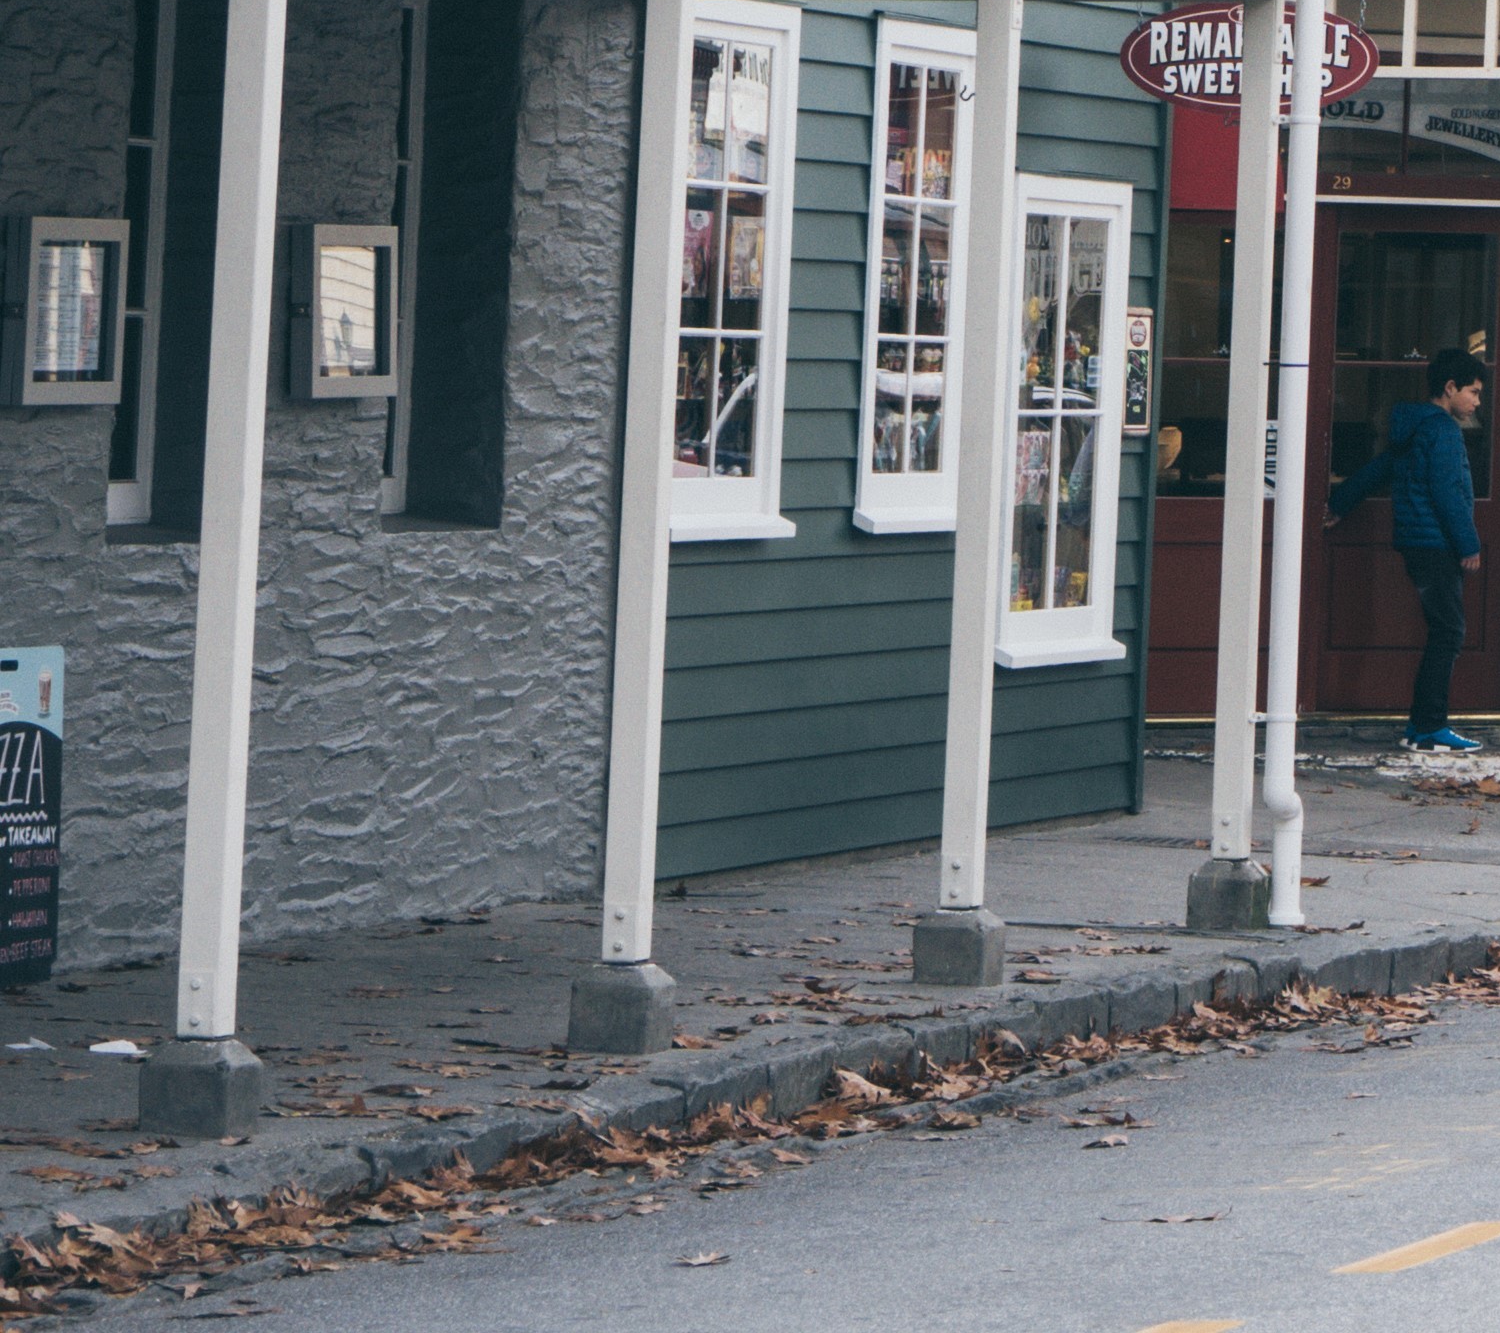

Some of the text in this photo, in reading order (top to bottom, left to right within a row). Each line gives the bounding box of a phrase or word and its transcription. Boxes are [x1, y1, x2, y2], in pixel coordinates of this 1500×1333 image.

[1149, 21, 1352, 68] REMAALE
[1319, 99, 1385, 123] OLD
[1332, 175, 1353, 190] 29
[8, 826, 57, 846] TAKEAWAY
[12, 877, 51, 896] PEPPERONI
[31, 938, 53, 959] STEAK
